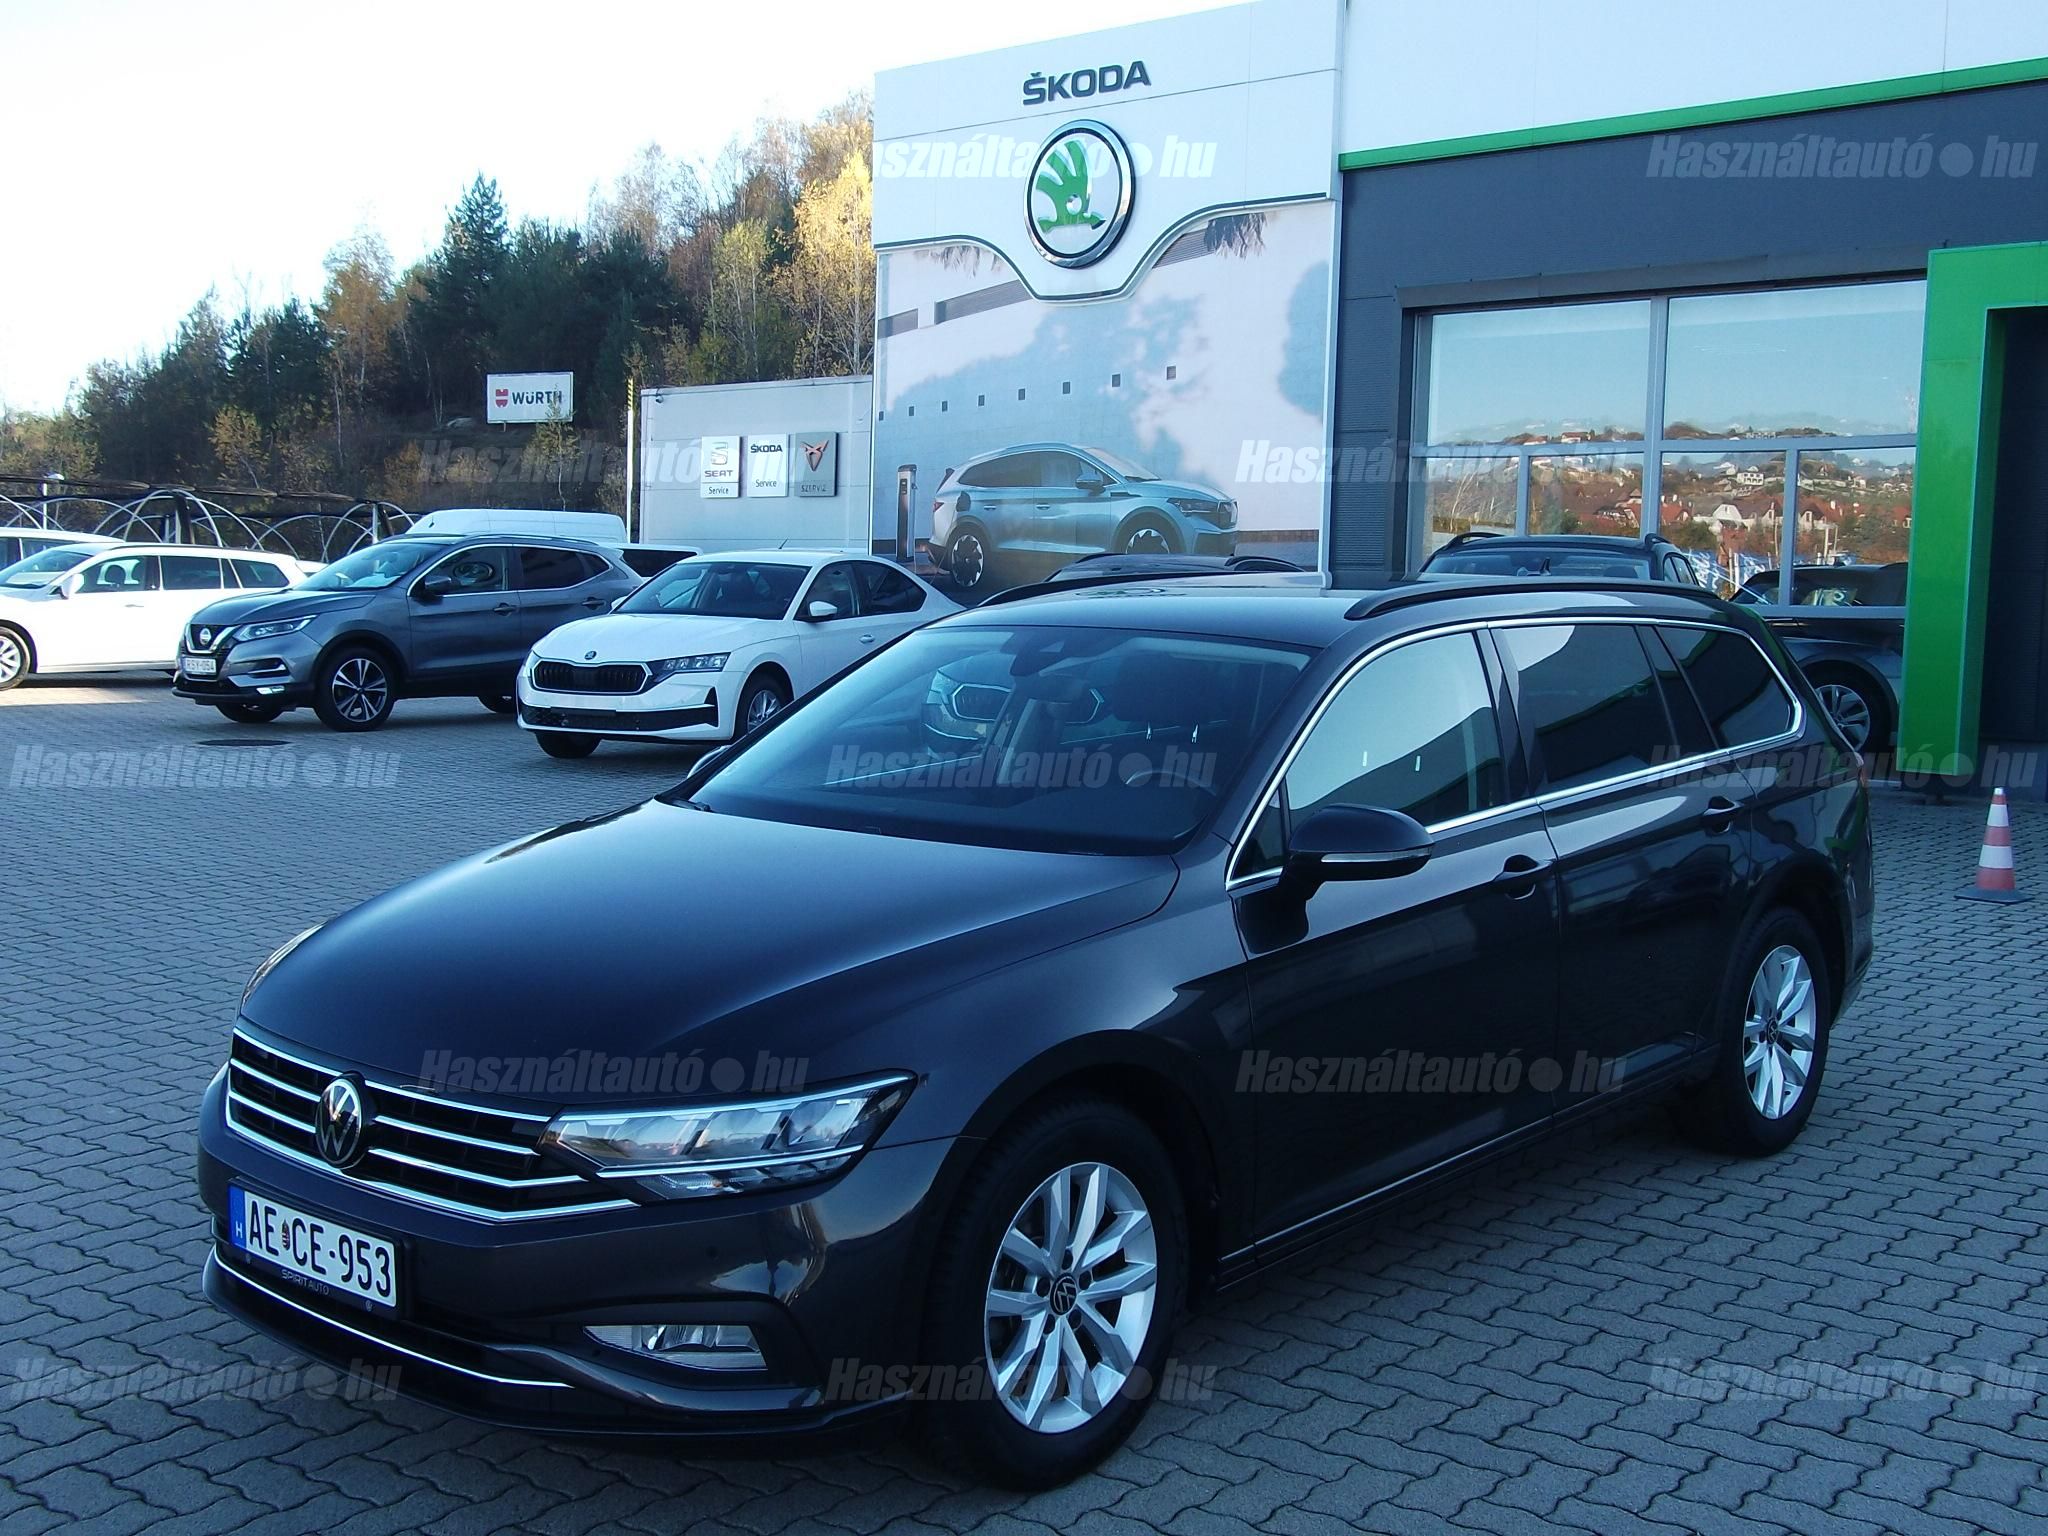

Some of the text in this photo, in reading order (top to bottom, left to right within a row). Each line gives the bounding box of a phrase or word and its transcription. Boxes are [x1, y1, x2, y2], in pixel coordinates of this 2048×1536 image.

[1023, 60, 1152, 105] ŠKODA
[512, 391, 562, 405] WÜRTH
[750, 444, 783, 454] ŠKODA
[755, 479, 777, 488] Service
[708, 486, 729, 495] Service
[281, 1269, 330, 1296] SPIRIT AUTO
